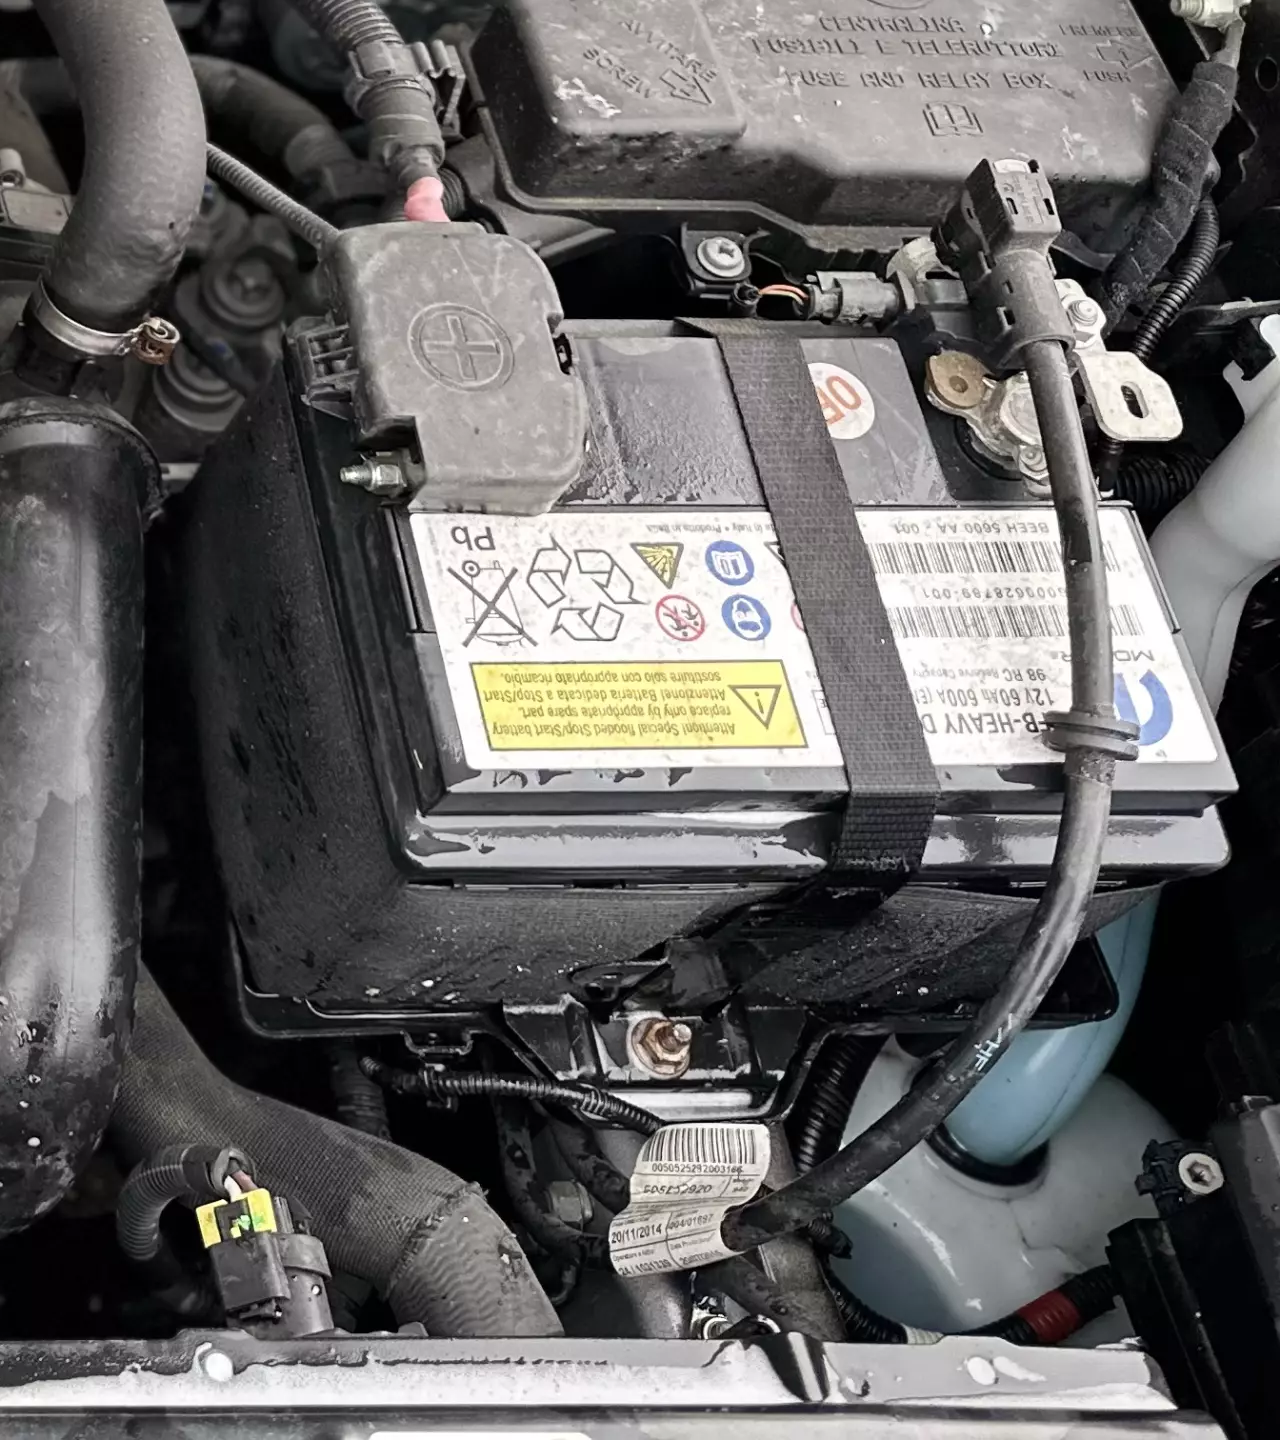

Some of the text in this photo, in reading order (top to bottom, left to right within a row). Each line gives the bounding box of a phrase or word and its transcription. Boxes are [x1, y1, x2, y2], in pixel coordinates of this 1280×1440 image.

[818, 15, 966, 33] CENTRALINA
[860, 70, 906, 89] AND
[917, 71, 992, 90] RELAY
[1001, 72, 1054, 90] BOX
[450, 525, 496, 551] Pb
[500, 670, 722, 686] sostituire solo con appropriato ricambio.
[1005, 668, 1025, 682] RC
[1028, 668, 1047, 682] 98
[483, 687, 543, 704] Stop/Start
[555, 687, 608, 702] dedicata
[609, 687, 656, 703] Batteria
[659, 687, 726, 702] Attenzione!
[547, 705, 578, 719] spare
[581, 705, 645, 720] appropriate
[648, 706, 661, 720] by
[663, 706, 688, 720] only
[689, 706, 731, 720] replace
[491, 720, 736, 737] Attention! Special flooded Stop/Start battery
[611, 1223, 663, 1244] 20/11/2014
